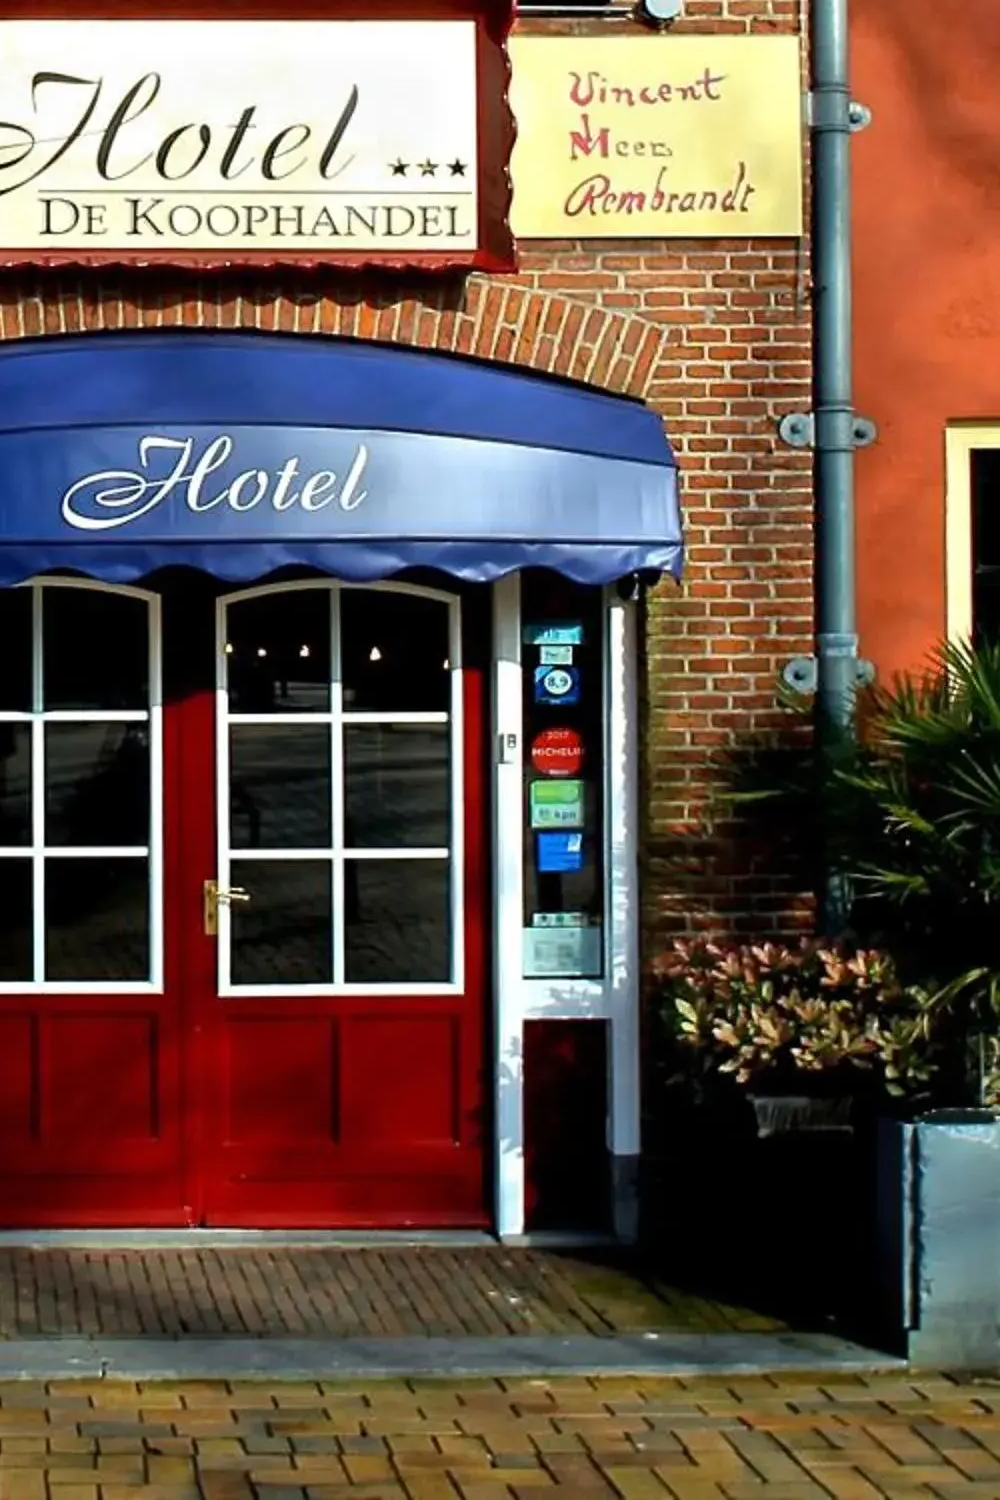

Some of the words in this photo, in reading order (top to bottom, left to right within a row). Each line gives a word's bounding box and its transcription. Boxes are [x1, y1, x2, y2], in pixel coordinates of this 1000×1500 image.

[568, 68, 729, 107] Vincent
[564, 162, 756, 217] Rembrandt
[37, 198, 108, 236] DE
[125, 198, 471, 237] KOOPHANDEL
[61, 434, 368, 531] Hotel
